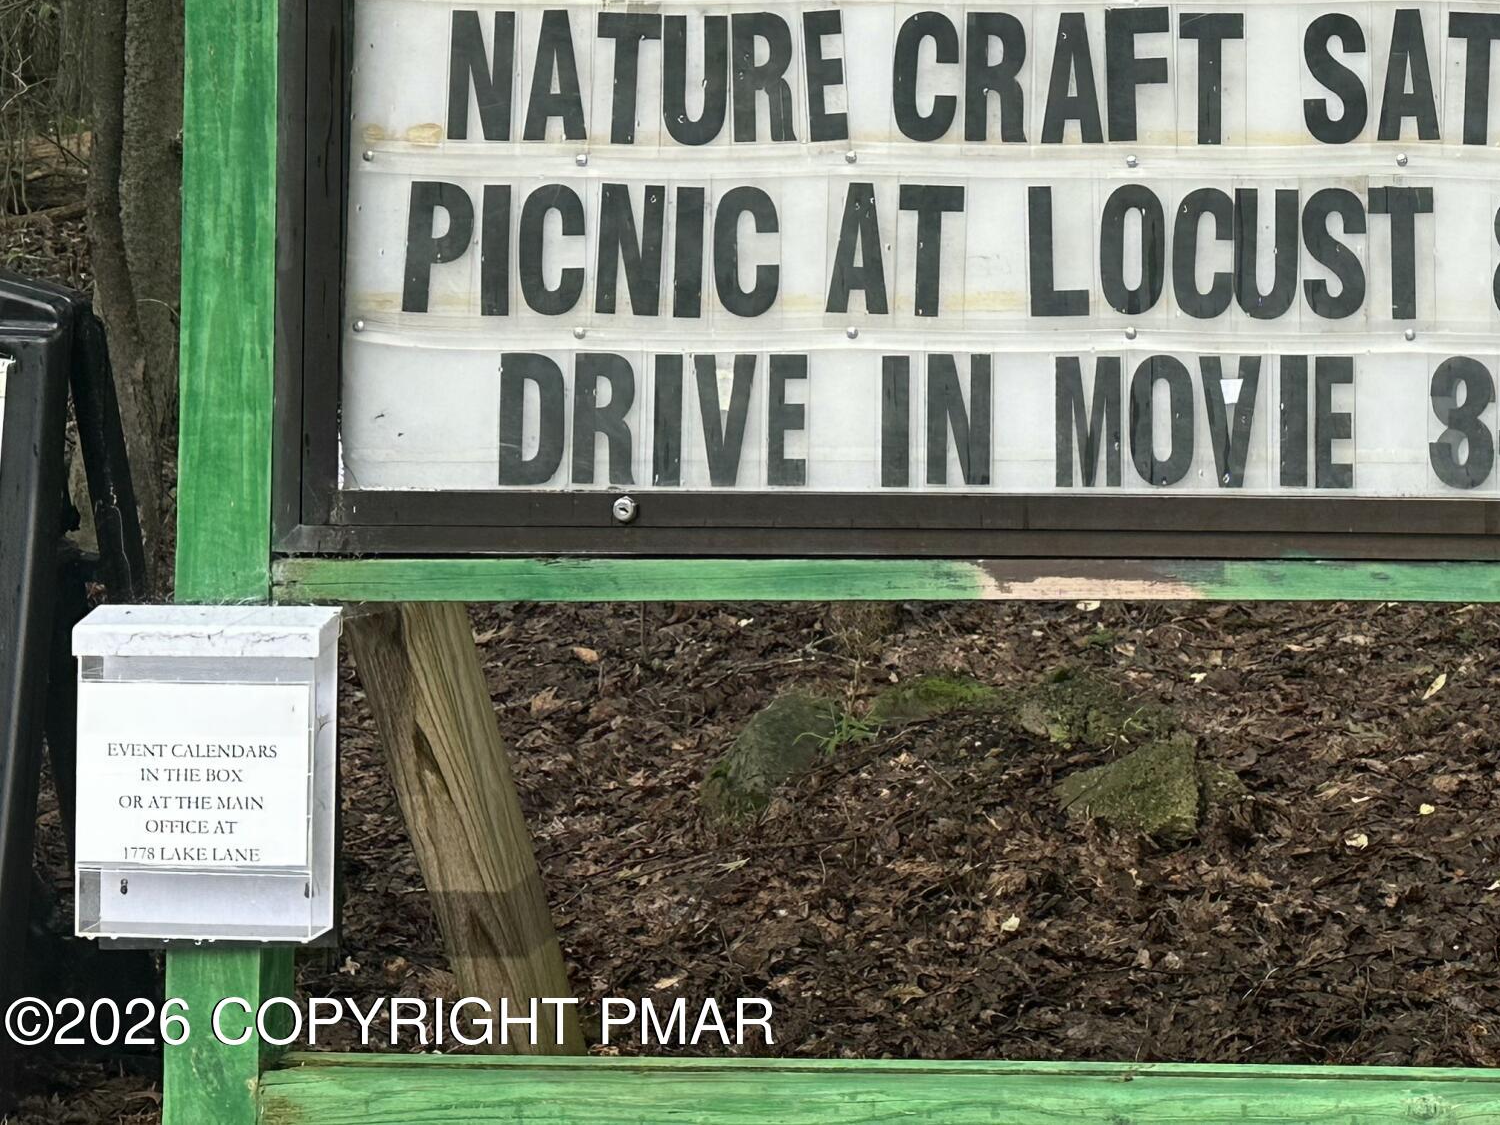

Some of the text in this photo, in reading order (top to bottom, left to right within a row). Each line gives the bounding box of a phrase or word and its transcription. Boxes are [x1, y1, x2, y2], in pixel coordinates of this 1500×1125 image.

[447, 9, 848, 146] NATURE
[893, 6, 1245, 145] CRAFT
[402, 181, 780, 318] PICNIC
[826, 182, 965, 317] AT
[1029, 183, 1434, 320] LOCUST
[498, 352, 808, 487] DRIVE
[881, 353, 992, 486] IN
[1055, 354, 1355, 489] MOVIE
[107, 742, 278, 758] EVENT CALENDARS
[140, 768, 243, 783] IN THE BOX
[118, 795, 264, 810] OR AT THE MAIN
[145, 820, 238, 835] OFFICE AT
[123, 847, 261, 862] 1778 LAKE LANE
